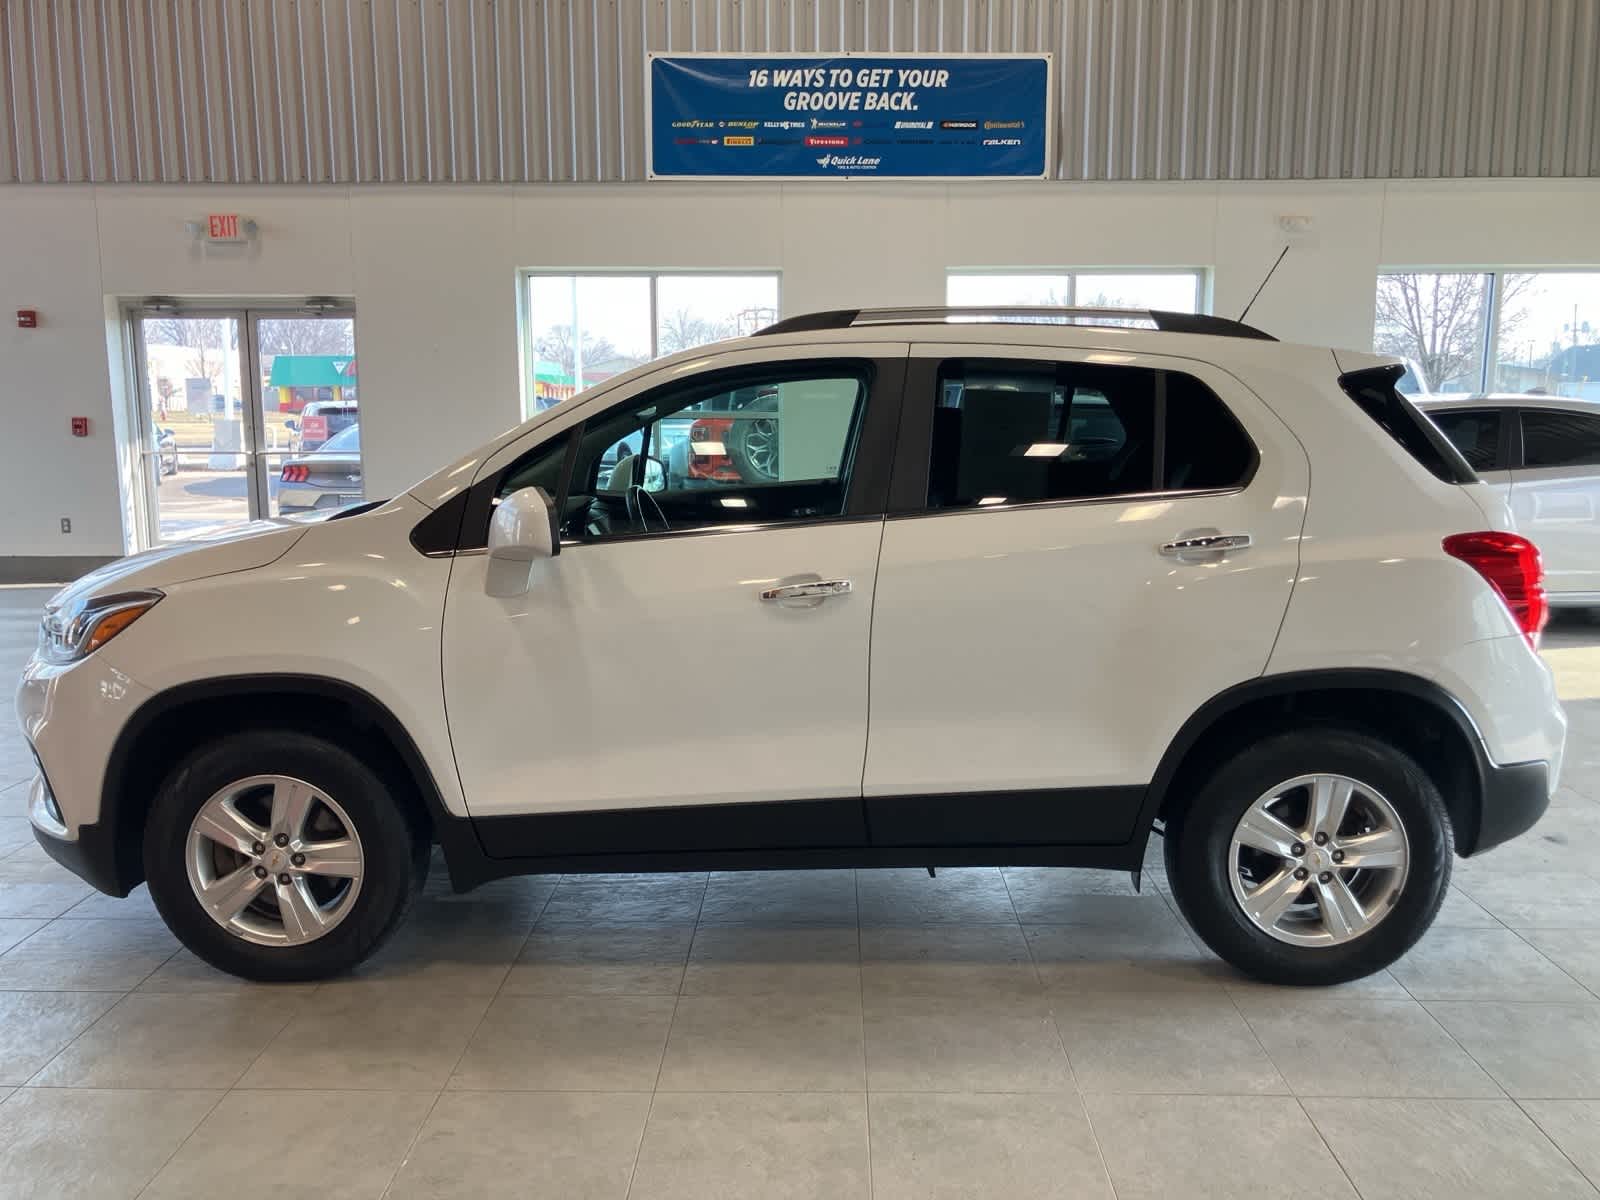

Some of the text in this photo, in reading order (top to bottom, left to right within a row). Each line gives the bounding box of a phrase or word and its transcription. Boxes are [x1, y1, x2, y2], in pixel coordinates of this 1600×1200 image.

[749, 69, 950, 88] 16 WAYS TO GET YOUR
[783, 92, 918, 111] GROOVE BACK.
[830, 155, 881, 165] Quick Lane
[209, 215, 238, 238] EXIT
